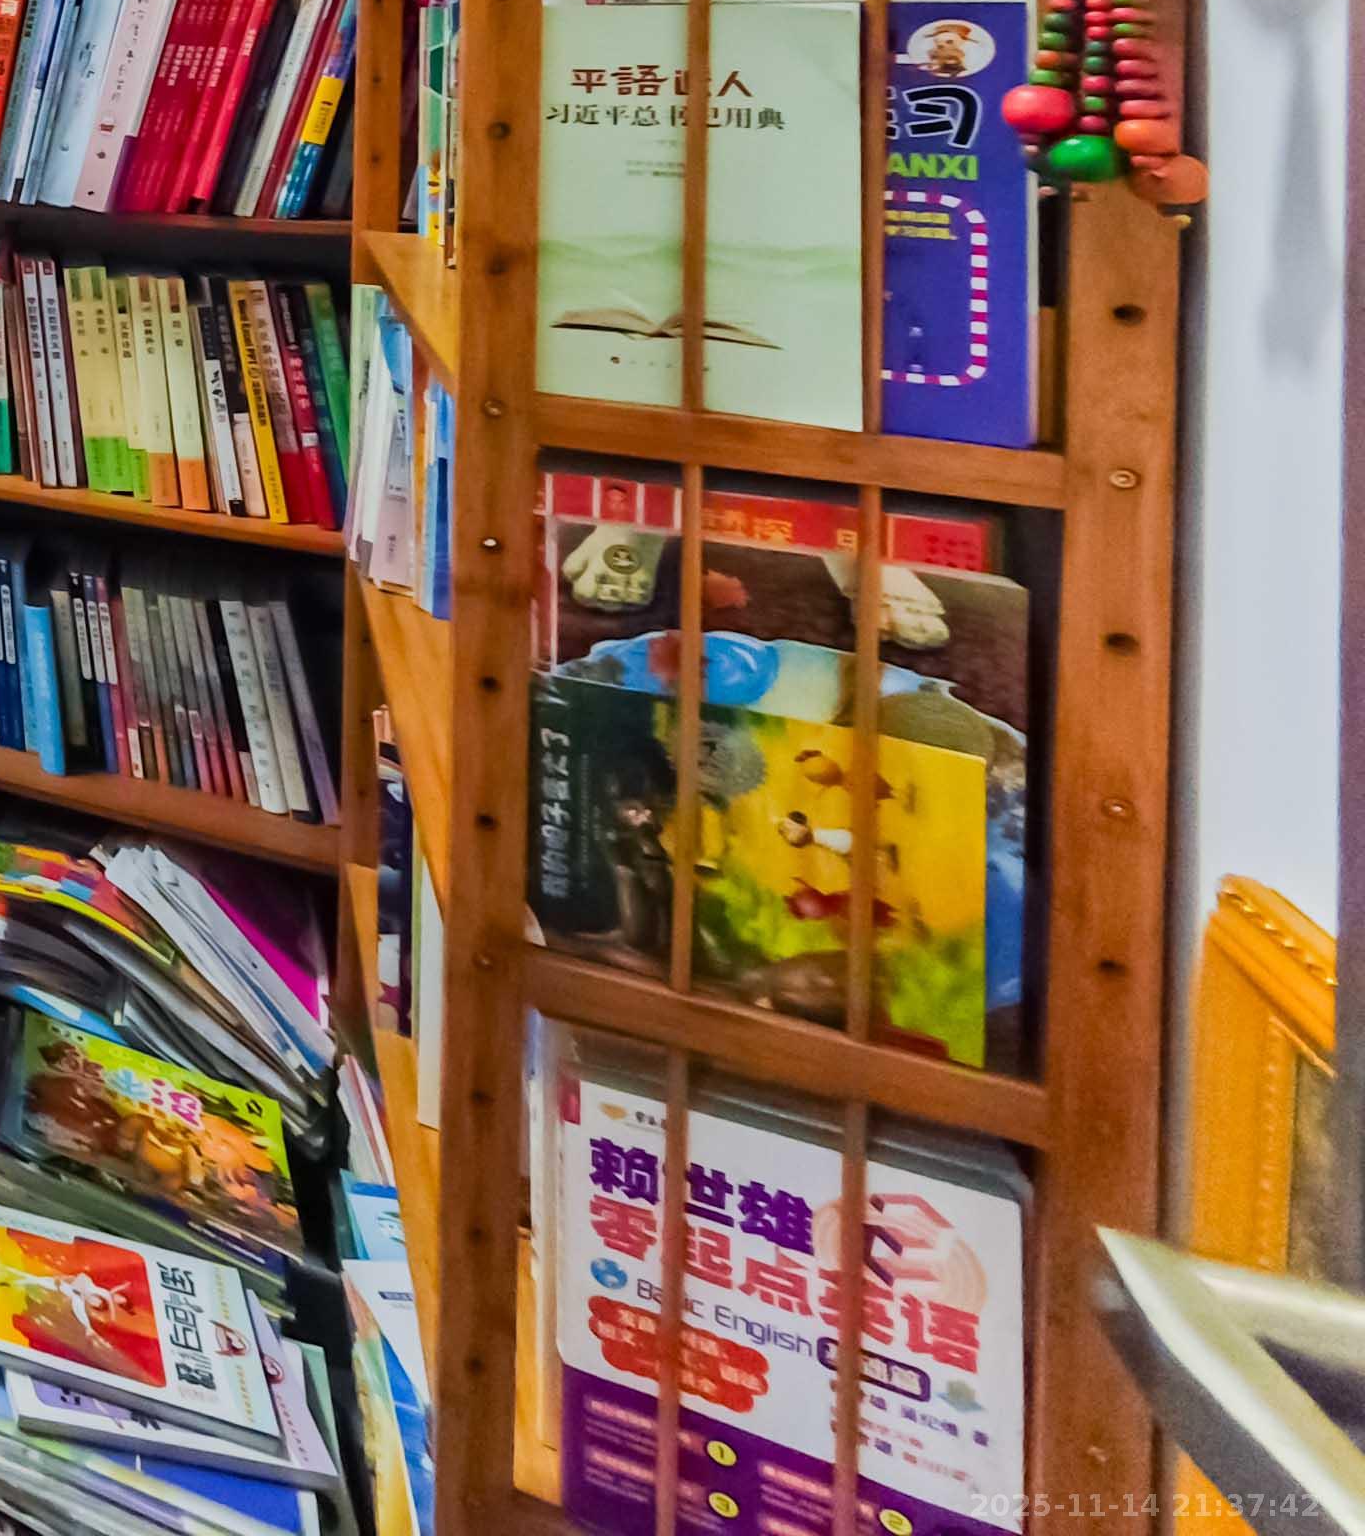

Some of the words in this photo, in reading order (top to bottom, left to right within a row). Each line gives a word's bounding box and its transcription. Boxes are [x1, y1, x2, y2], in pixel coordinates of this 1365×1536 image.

[885, 83, 983, 149] 习
[886, 152, 980, 181] ANXI
[589, 1137, 815, 1256] 赖世雄
[589, 1194, 981, 1375] 零起点英语
[636, 1277, 705, 1319] Baic
[714, 1304, 813, 1359] English
